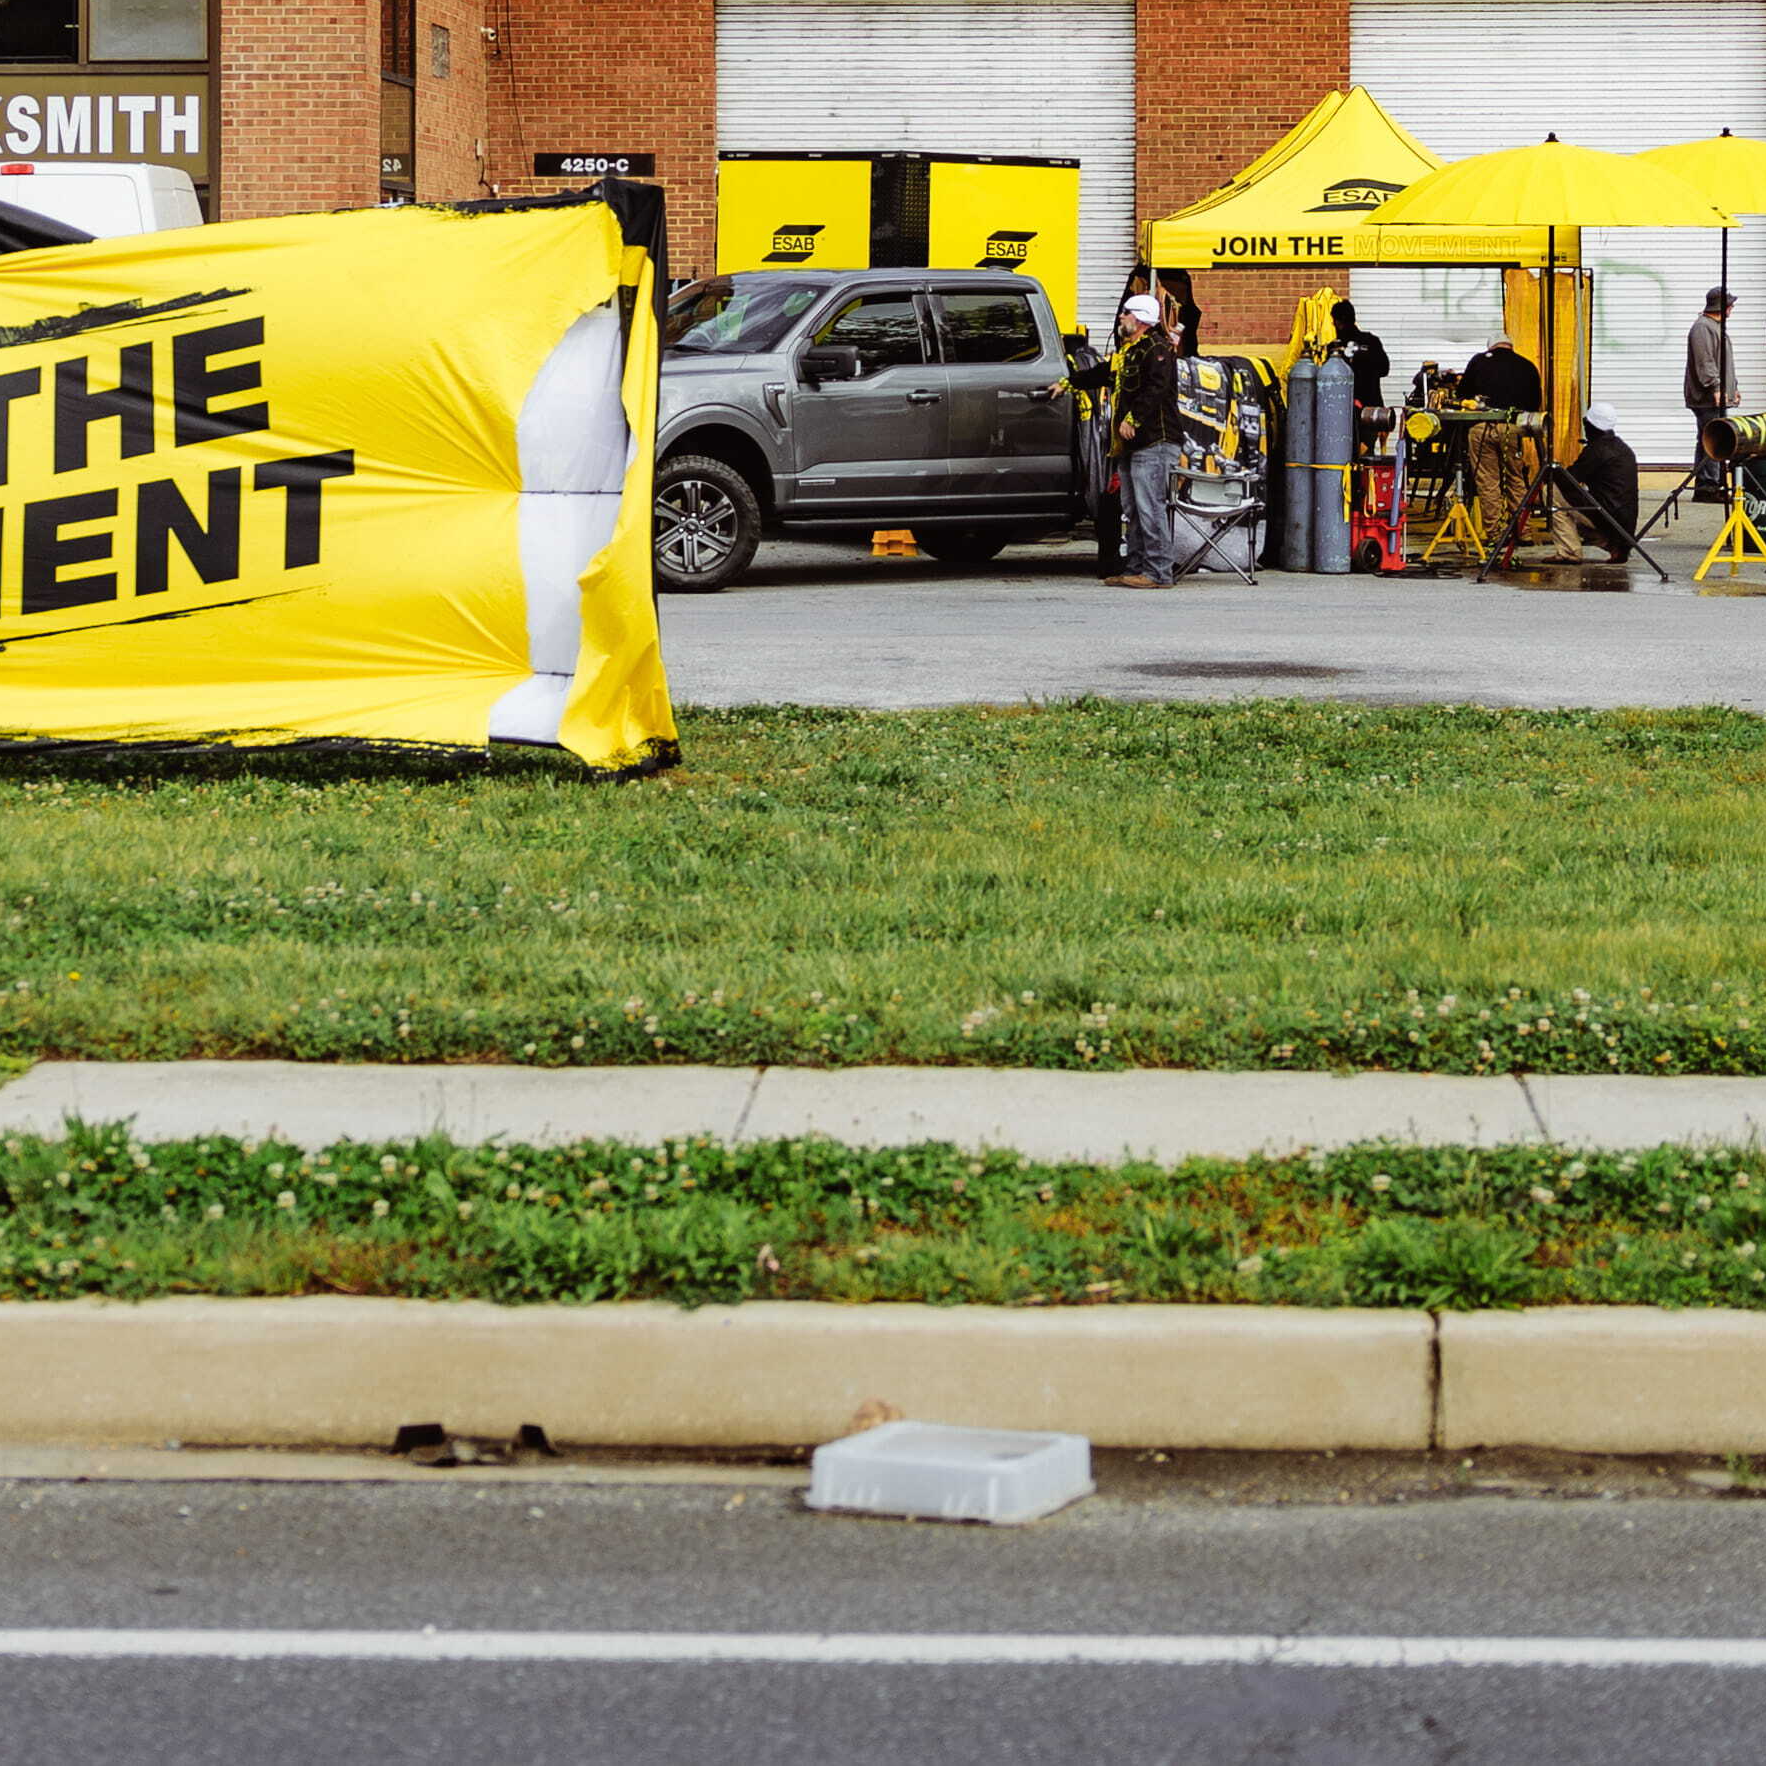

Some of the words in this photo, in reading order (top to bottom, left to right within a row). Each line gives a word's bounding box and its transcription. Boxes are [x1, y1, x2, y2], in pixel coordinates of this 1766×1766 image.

[560, 158, 630, 172] 4250-C
[772, 237, 815, 251] ESAB
[985, 242, 1028, 257] ESAB
[1212, 236, 1277, 256] JOIN
[1288, 236, 1344, 256] THE
